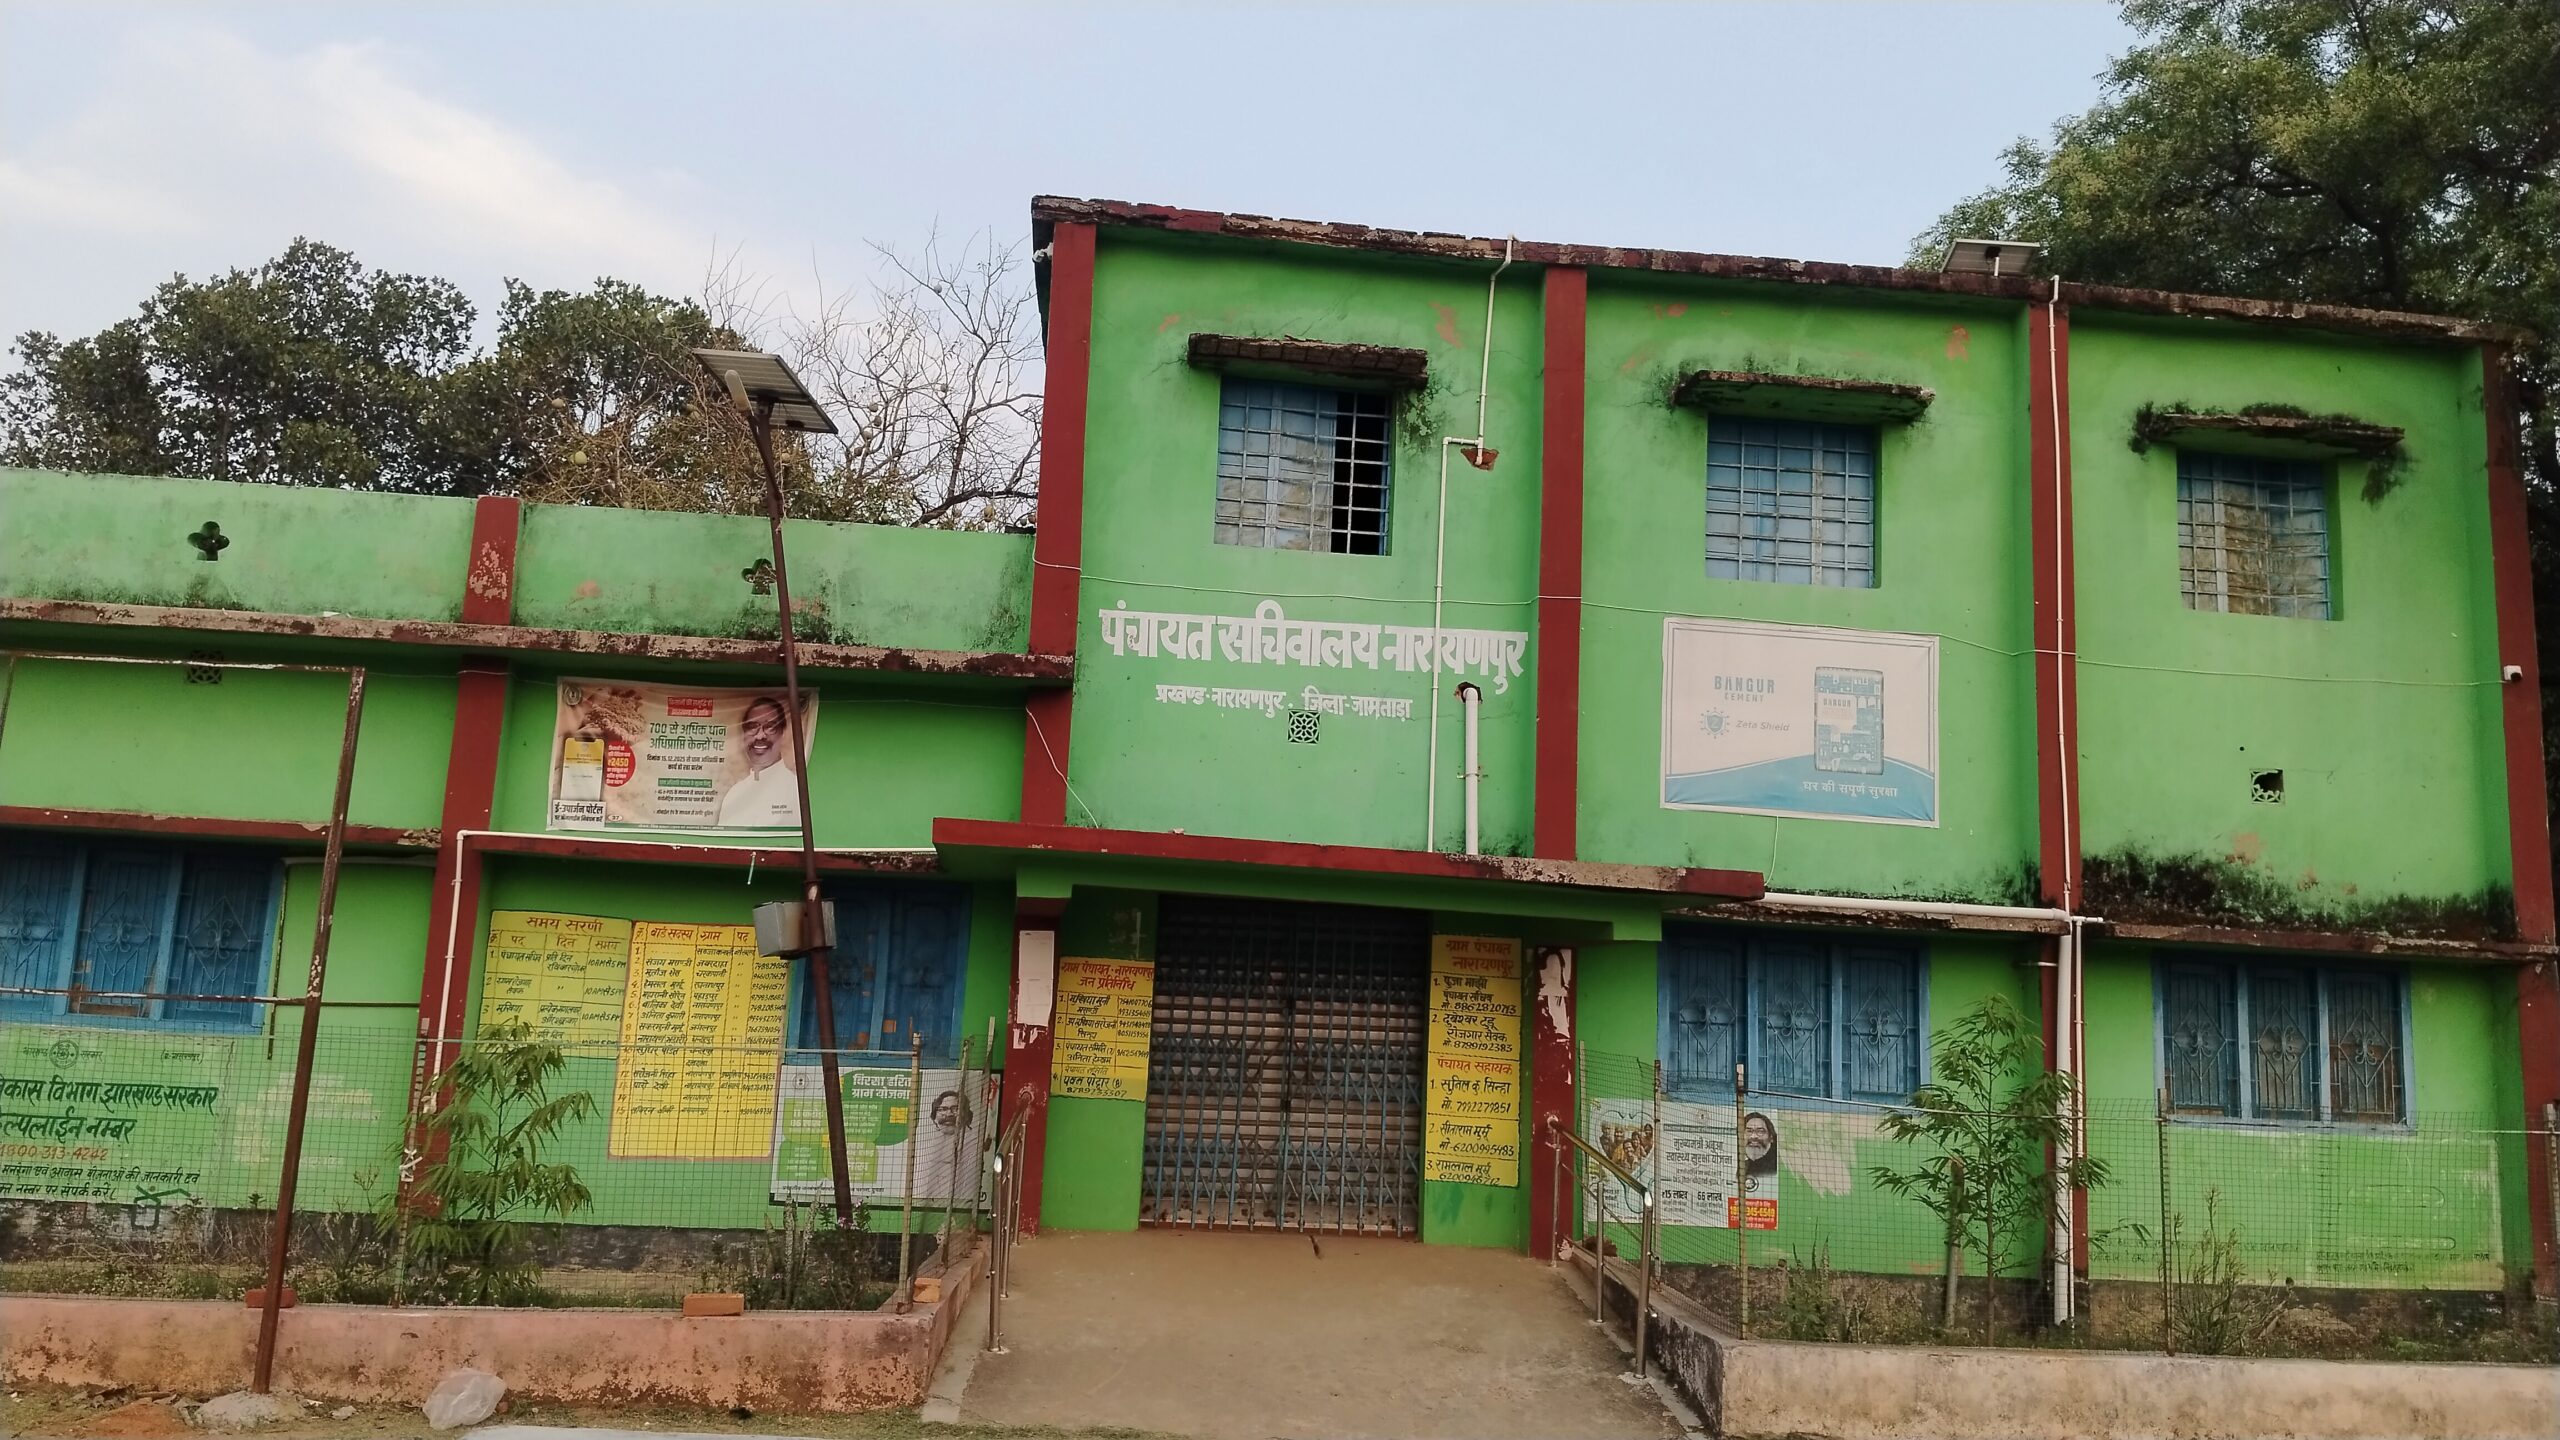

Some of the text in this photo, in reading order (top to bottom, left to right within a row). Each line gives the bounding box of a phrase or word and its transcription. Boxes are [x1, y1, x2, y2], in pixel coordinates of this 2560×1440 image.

[1099, 600, 1529, 695] पंचायत सचिवालय नारायणपुर
[1714, 675, 1775, 694] BANGUR
[1725, 692, 1764, 702] CEMENT
[650, 721, 727, 736] 700 से अधिक धान
[1736, 720, 1790, 732] Zeta Shield
[650, 735, 686, 749] अधिप्राप्ति
[712, 740, 725, 751] पर
[1803, 781, 1818, 791] घर
[1822, 780, 1834, 792] की
[1868, 786, 1897, 799] सुरक्षा
[586, 803, 604, 815] पोर्टल
[527, 916, 603, 932] समय सरणी
[511, 935, 621, 950] पद दिन समय
[650, 926, 749, 943] वार्ड सदस्य ग्राम पद
[1445, 938, 1512, 955] ग्राम पंचायत
[1062, 962, 1080, 974] ग्राम
[1081, 960, 1111, 976] पंचायत
[1078, 975, 1137, 992] जन प्रतिनिधि
[1446, 1026, 1508, 1043] रोजगार सेवक
[1437, 1056, 1513, 1076] पंचायत सहायक
[852, 1073, 885, 1087] बिरसा
[1440, 1074, 1470, 1096] सुनिल
[1483, 1076, 1512, 1094] सिन्हा
[48, 1074, 101, 1103] विभाग
[100, 1082, 164, 1114] झारखण्ड
[163, 1085, 219, 1116] सरकार
[851, 1085, 911, 1100] ग्राम योजना
[0, 1105, 137, 1144] ल्पलाईन नम्बर
[1440, 1119, 1473, 1137] सीताराम
[1435, 1159, 1474, 1173] रामलाल
[1690, 1153, 1711, 1166] सुरक्षा
[1711, 1155, 1733, 1166] योजना
[50, 1165, 83, 1180] आवास
[124, 1165, 139, 1181] की
[141, 1166, 182, 1183] जानकारी
[44, 1185, 57, 1197] पर
[60, 1181, 90, 1198] संपर्क
[1672, 1190, 1688, 1200] लाख
[1697, 1191, 1723, 1202] 66 लाख
